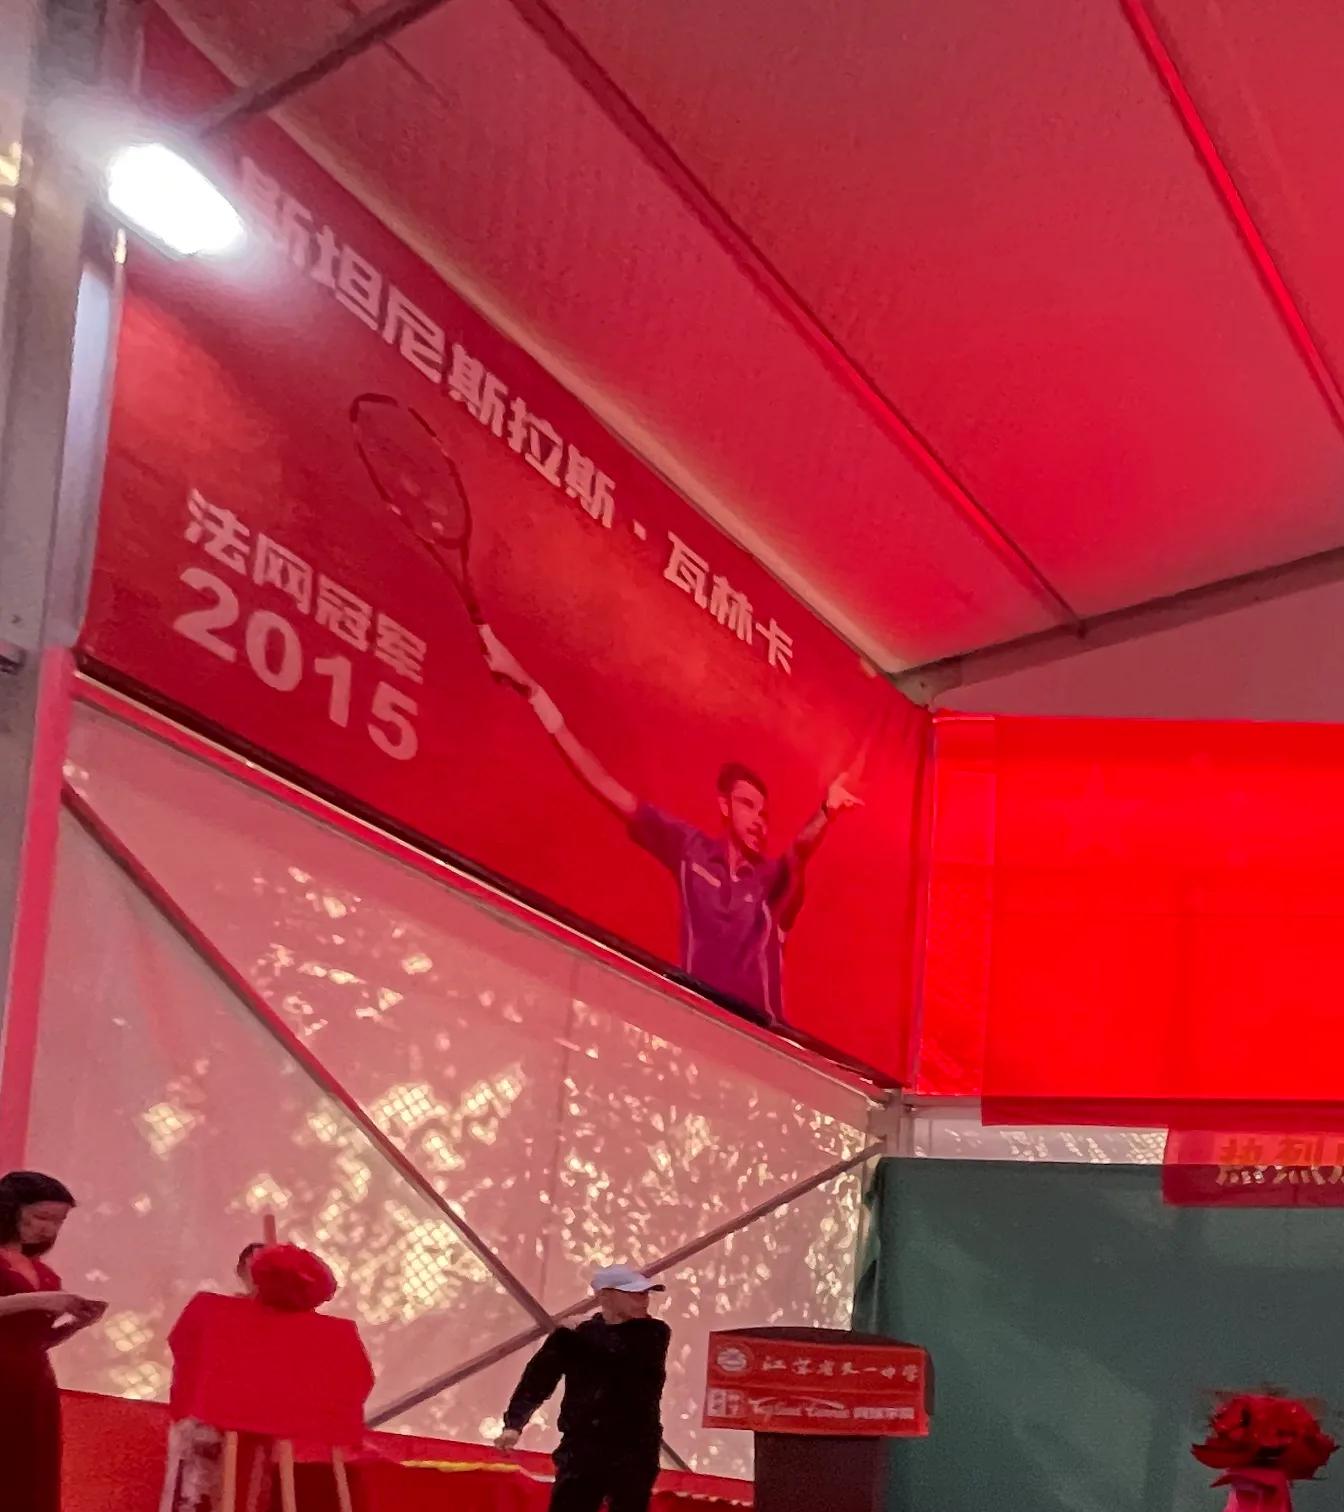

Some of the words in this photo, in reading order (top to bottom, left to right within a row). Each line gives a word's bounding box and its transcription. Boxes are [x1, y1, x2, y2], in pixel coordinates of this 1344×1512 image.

[173, 566, 419, 761] 2015
[184, 487, 427, 685] 法网冠军
